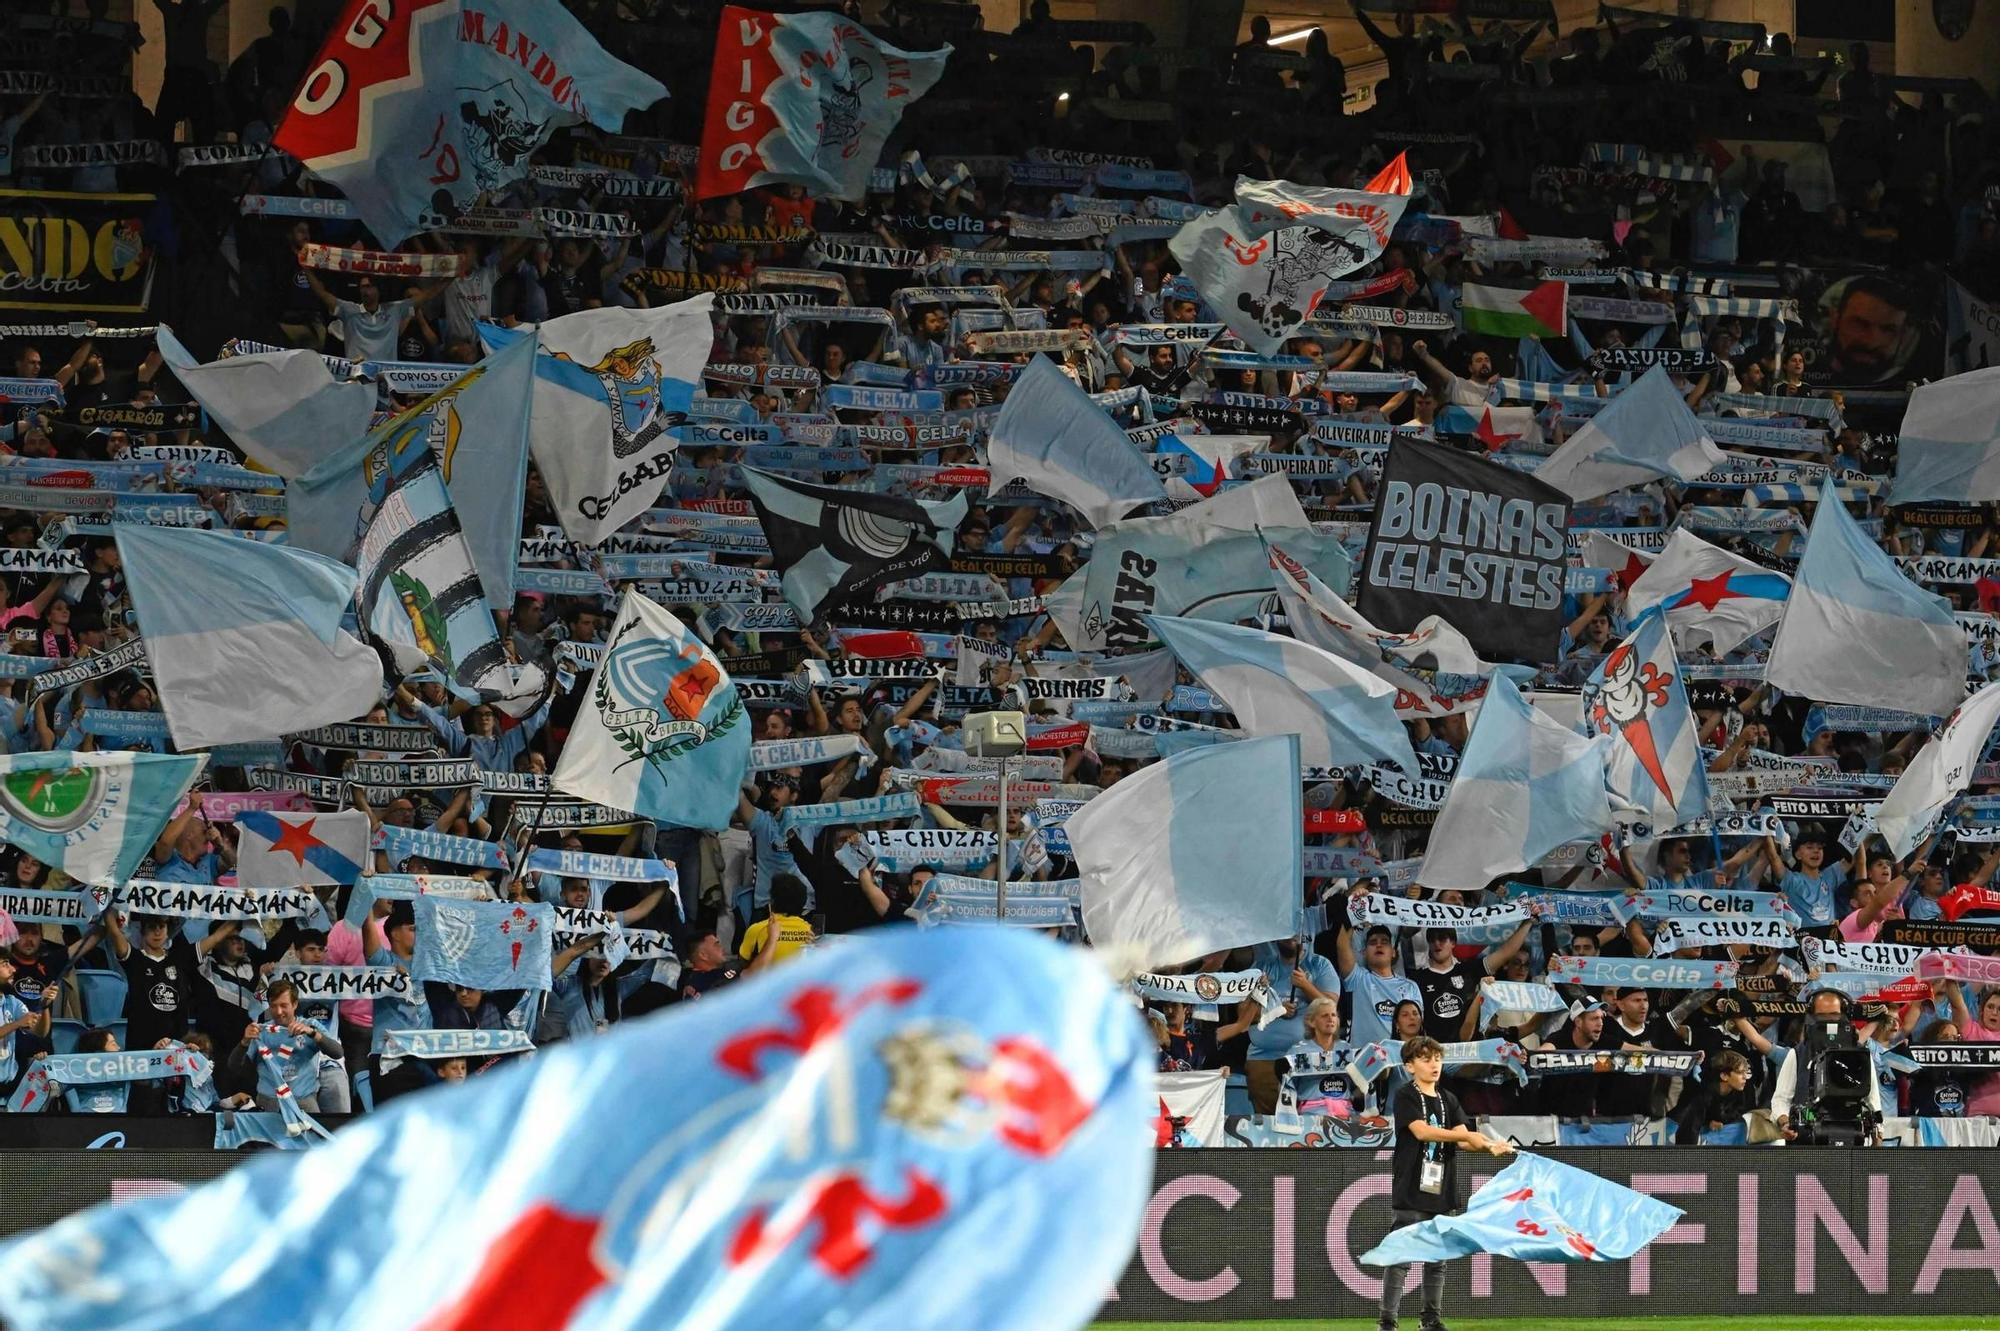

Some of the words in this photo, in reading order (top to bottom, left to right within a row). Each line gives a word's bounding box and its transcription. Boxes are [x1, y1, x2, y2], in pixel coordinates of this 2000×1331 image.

[719, 17, 763, 171] VIGO
[1139, 324, 1209, 343] RCCelta
[389, 371, 436, 384] CORVOS
[851, 391, 878, 408] RC
[883, 392, 920, 410] CELTA
[694, 427, 770, 445] RCCelta
[856, 427, 908, 444] EURO
[1129, 432, 1146, 446] DE
[1261, 457, 1315, 475] OLIVEIRA
[1317, 458, 1333, 474] DE
[1731, 470, 1778, 484] CELTAS
[695, 501, 742, 515] UNITED
[1379, 481, 1565, 559] BOINAS
[1903, 511, 1929, 526] REAL
[1931, 512, 1955, 527] CLUB
[1957, 512, 1984, 528] CELTA
[1637, 533, 1664, 549] TEIS
[888, 562, 907, 572] DE
[951, 560, 982, 573] REAL
[984, 562, 1014, 575] CLUB
[1016, 562, 1047, 576] CELTA
[1368, 542, 1562, 610] CELESTES
[909, 577, 980, 595] CELTA
[36, 660, 95, 691] FUTBOL
[828, 658, 935, 679] BOINAS
[1025, 677, 1107, 700] BOINAS
[93, 710, 124, 722] NOSA
[604, 711, 655, 726] CELTA
[358, 730, 369, 746] E
[373, 729, 434, 749] BIRRAS
[657, 722, 704, 740] BIRRAS
[768, 742, 828, 765] CELTA
[409, 765, 421, 782] E
[320, 780, 332, 797] E
[580, 809, 591, 824] E
[1774, 801, 1808, 815] FEITO
[1811, 801, 1830, 816] NA
[1380, 811, 1410, 826] REAL
[392, 839, 401, 851] E
[399, 828, 485, 852] AFOUTEZA
[562, 851, 583, 870] RC
[587, 854, 646, 875] CELTA
[33, 899, 53, 917] DE
[1667, 893, 1754, 913] RCCelta
[1893, 928, 1928, 944] REAL
[1931, 931, 1964, 946] CLUB
[281, 968, 408, 994] ARCAMÄNS
[1593, 961, 1702, 984] RCCelta
[1747, 977, 1775, 993] CELTA
[1755, 1002, 1784, 1016] REAL
[1529, 1053, 1598, 1070] CELTA
[1911, 1049, 1948, 1064] FEITO
[1950, 1049, 1971, 1064] NA
[52, 1055, 151, 1081] RCCelta
[150, 1057, 166, 1068] 23
